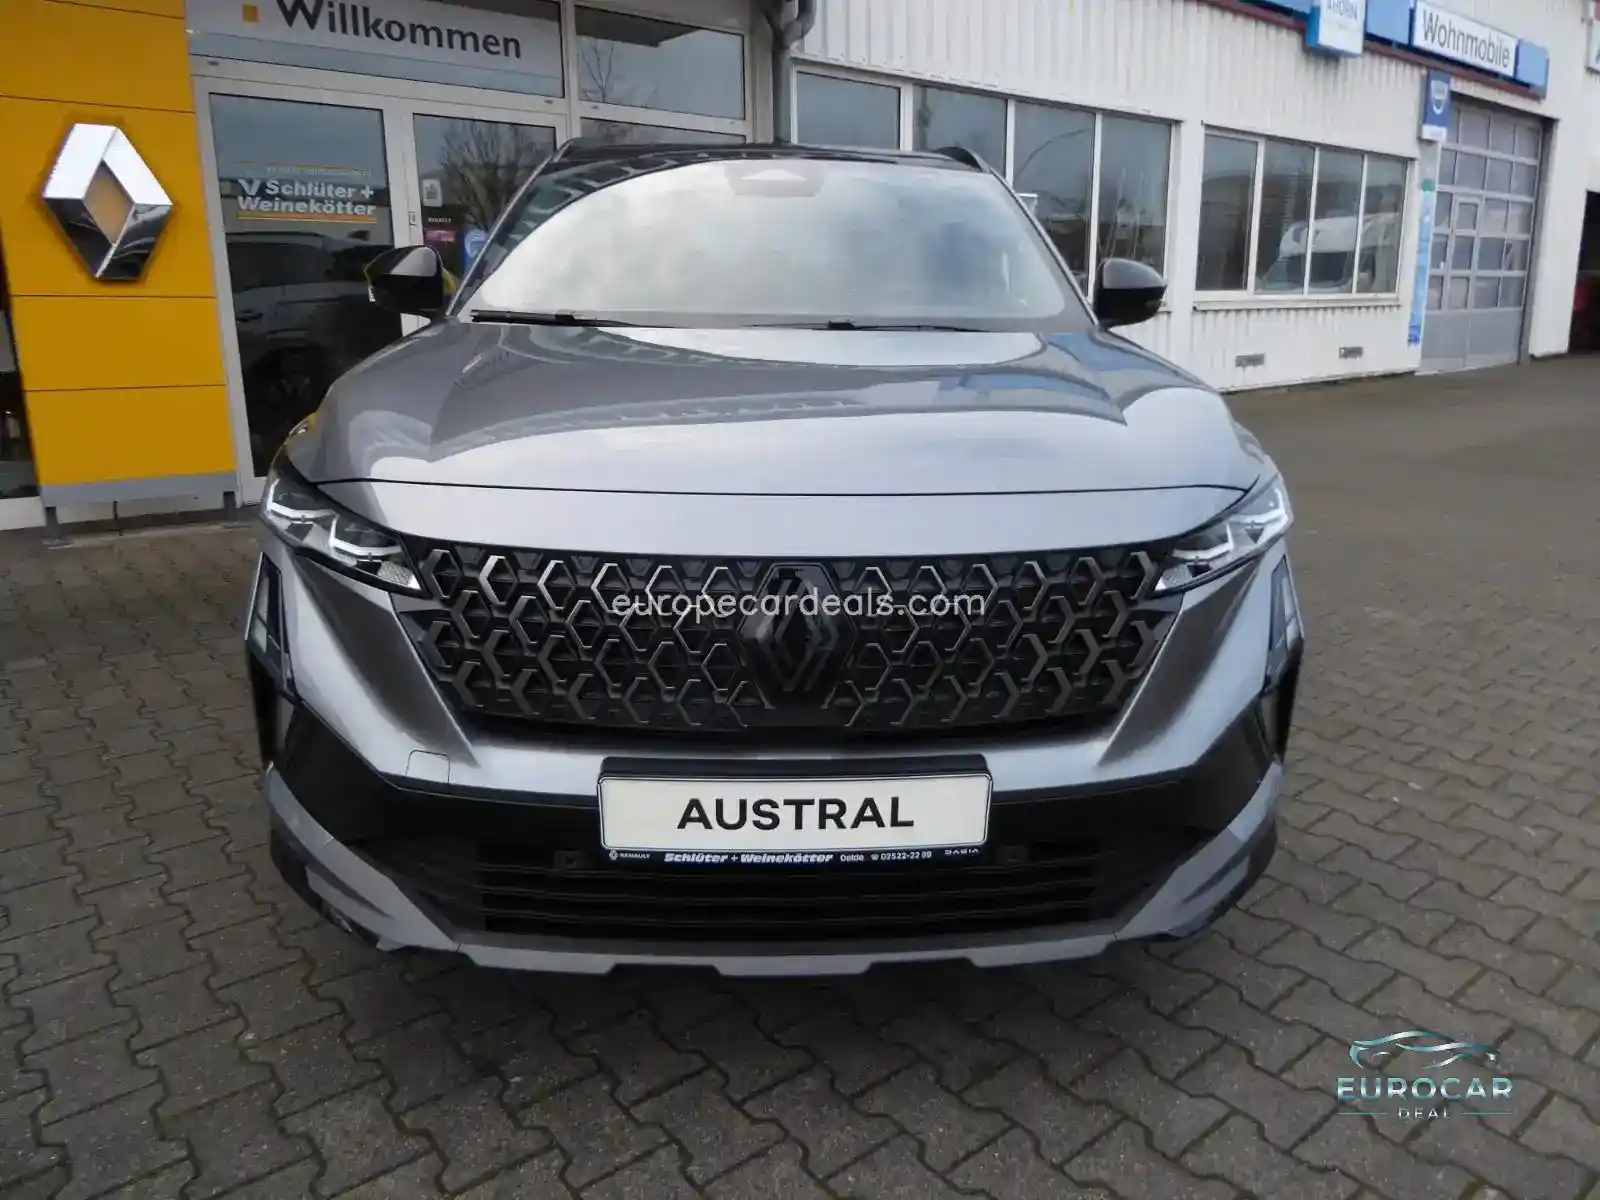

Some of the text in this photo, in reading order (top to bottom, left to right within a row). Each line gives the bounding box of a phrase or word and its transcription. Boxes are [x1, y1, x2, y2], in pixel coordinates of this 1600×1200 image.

[275, 0, 522, 58] Willkommen
[1422, 8, 1510, 69] Wohnmobile
[265, 178, 357, 199] Schlüter
[360, 185, 375, 199] +
[237, 195, 377, 216] Weinekötter
[677, 796, 914, 831] AUSTRAL
[664, 852, 729, 863] Schlüter
[731, 853, 739, 861] +
[740, 853, 834, 864] Weinekötter
